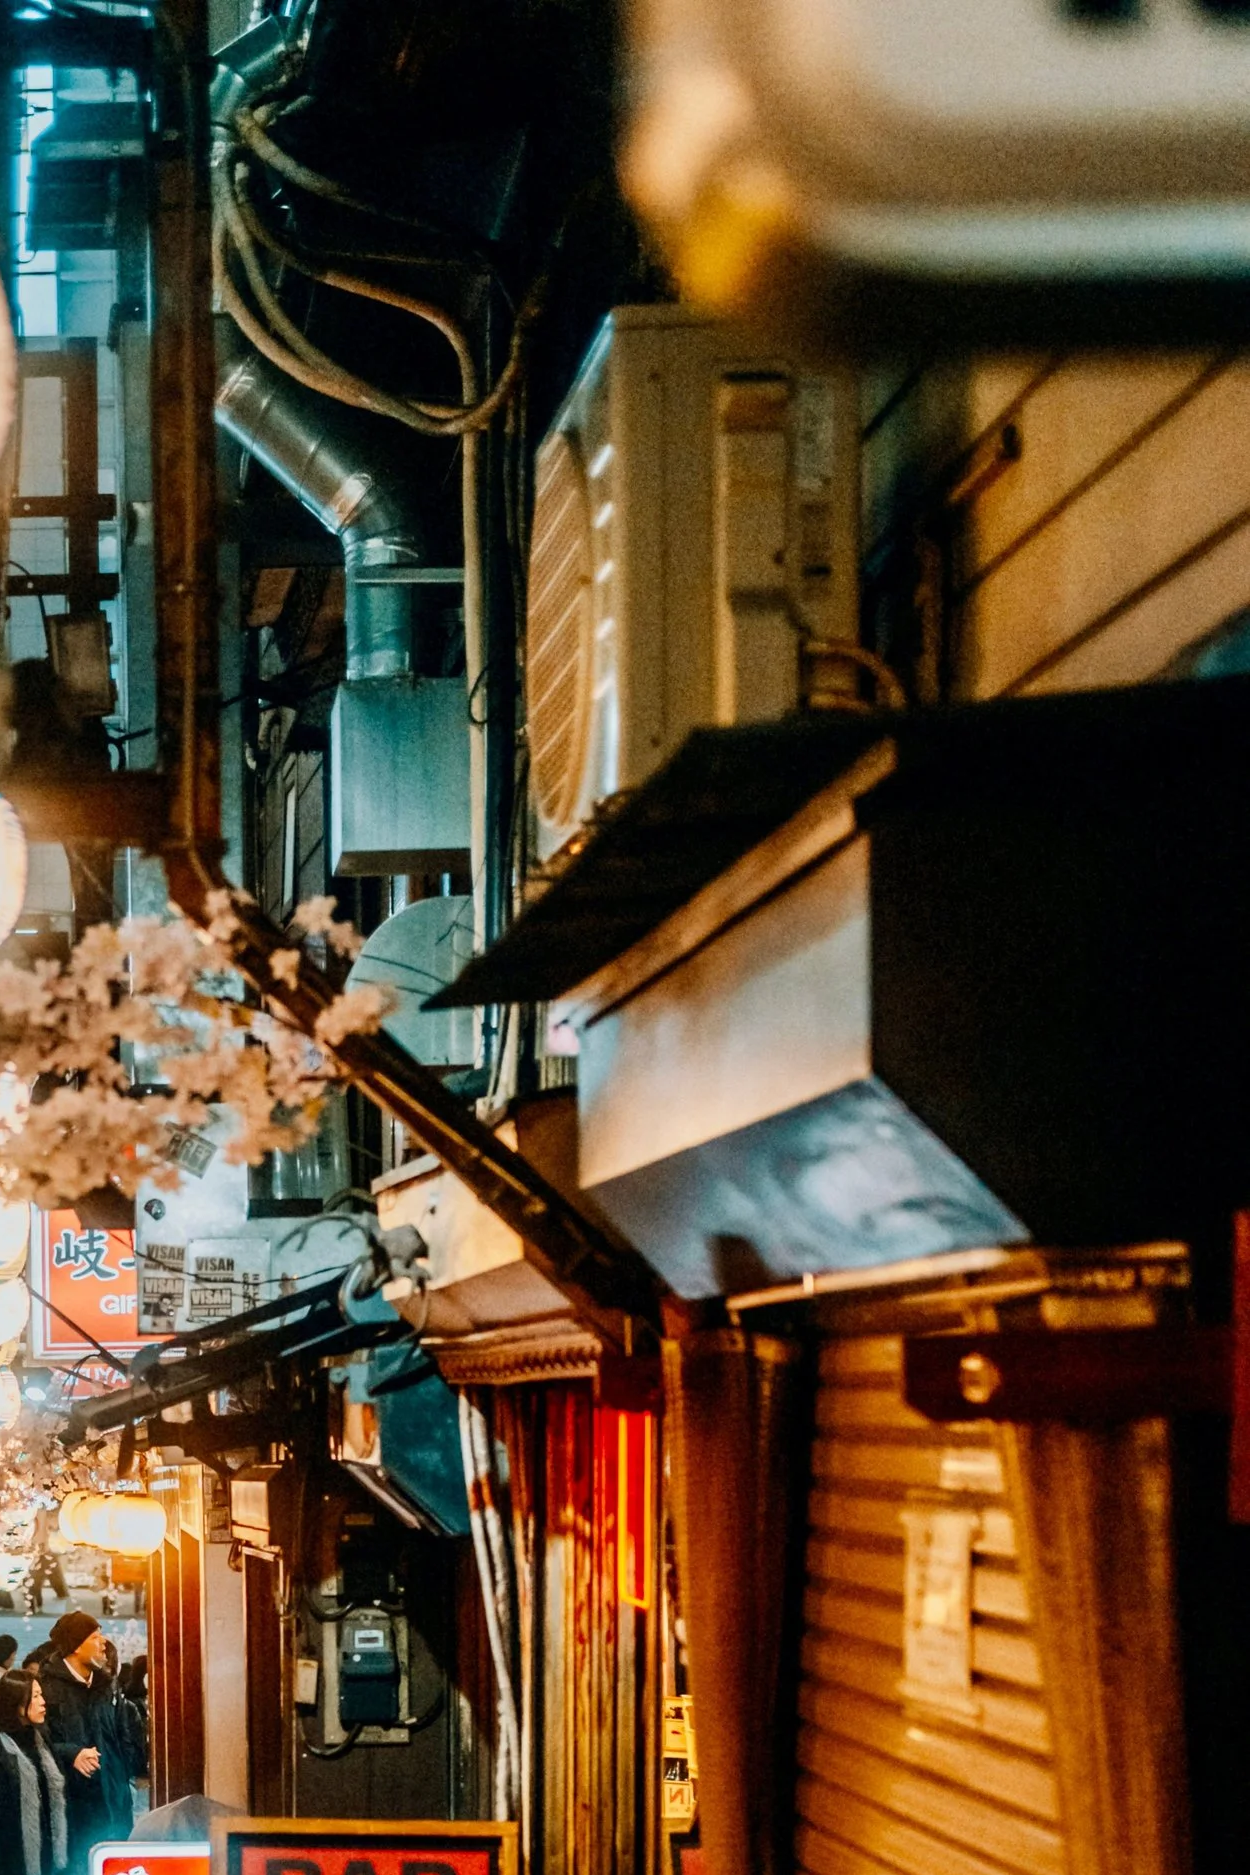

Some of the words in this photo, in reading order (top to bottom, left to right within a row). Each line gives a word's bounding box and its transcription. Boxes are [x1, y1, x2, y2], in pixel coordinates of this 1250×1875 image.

[54, 1230, 135, 1279] 岐
[195, 1256, 235, 1271] VISAH
[191, 1289, 231, 1305] VISAH
